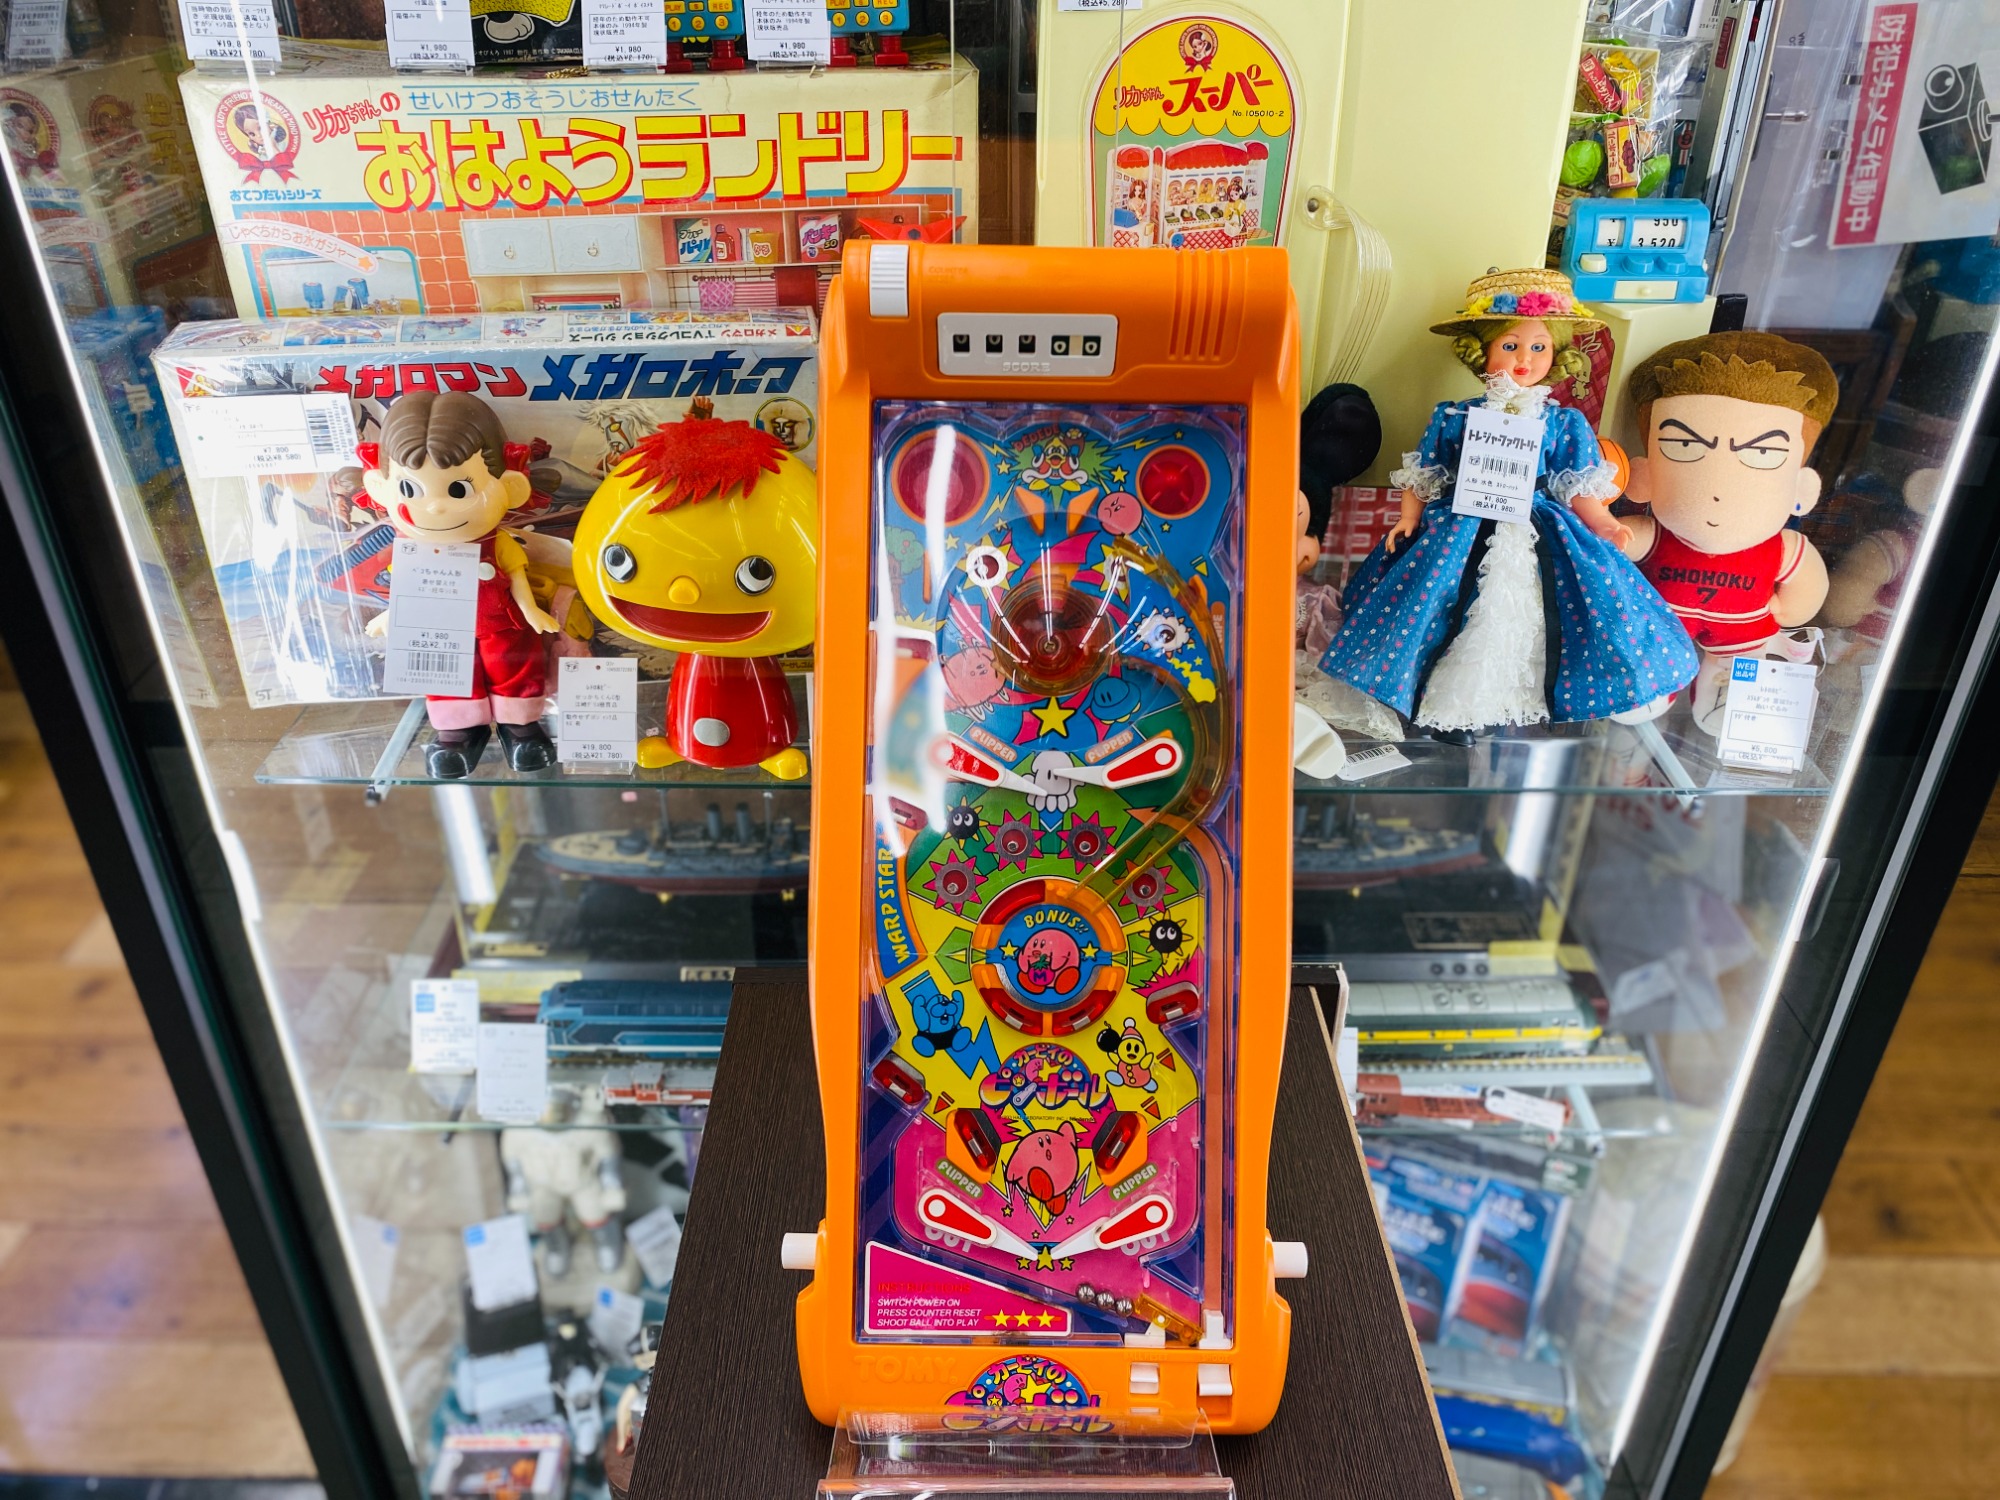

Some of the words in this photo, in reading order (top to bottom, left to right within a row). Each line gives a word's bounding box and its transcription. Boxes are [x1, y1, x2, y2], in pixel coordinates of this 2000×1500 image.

[712, 2, 729, 10] REC
[695, 20, 701, 29] 2
[719, 18, 725, 27] 3
[860, 15, 866, 23] 2
[882, 14, 889, 23] 3
[217, 40, 251, 48] ¥19,80
[408, 87, 697, 111] せいけつおそうじおせんたく
[1113, 85, 1164, 110] リカちゃん
[1162, 64, 1274, 117] スーパー
[1245, 109, 1285, 117] 105010-2
[1844, 13, 1907, 232] 防犯カメラ作動中
[1608, 131, 1618, 168] ミートボール
[354, 109, 963, 214] おはようランドリー
[229, 189, 322, 201] おてつだいシリーズ
[229, 224, 356, 259] じゃぐちからお水がジャー
[568, 331, 613, 343] シリーズ
[622, 330, 716, 343] TVコレクション
[314, 362, 528, 399] メガロマン
[528, 350, 814, 401] メガロホーク
[1002, 361, 1051, 372] SCORE
[1013, 423, 1060, 453] DEDEDE
[1468, 429, 1538, 452] トレジャーファクトリー
[1481, 479, 1493, 487] 水色
[1658, 566, 1756, 590] SHOHOKU
[1696, 587, 1718, 604] 7
[408, 640, 460, 650] (税込¥2,178)
[421, 632, 449, 640] ¥1,980
[1736, 662, 1757, 671] WEB
[972, 729, 1016, 761] FLIPPER
[1087, 732, 1133, 763] FLIPPER
[878, 848, 896, 899] STAR
[881, 903, 910, 964] WARP
[1013, 1043, 1074, 1067] カービィの
[979, 1067, 1110, 1110] ピンボール
[938, 1160, 982, 1198] FLIPPER
[1112, 1165, 1156, 1199] FLIPPER
[877, 1298, 911, 1307] SWITCH
[914, 1298, 945, 1307] POWER
[947, 1299, 961, 1307] ON
[877, 1308, 907, 1317] PRESS
[909, 1308, 951, 1317] COUNTER
[953, 1308, 981, 1317] RESET
[877, 1318, 908, 1327] SHOOT
[909, 1318, 931, 1327] BALL
[934, 1318, 956, 1327] INTO
[958, 1318, 980, 1327] PLAY
[987, 1356, 1067, 1384] カービィの
